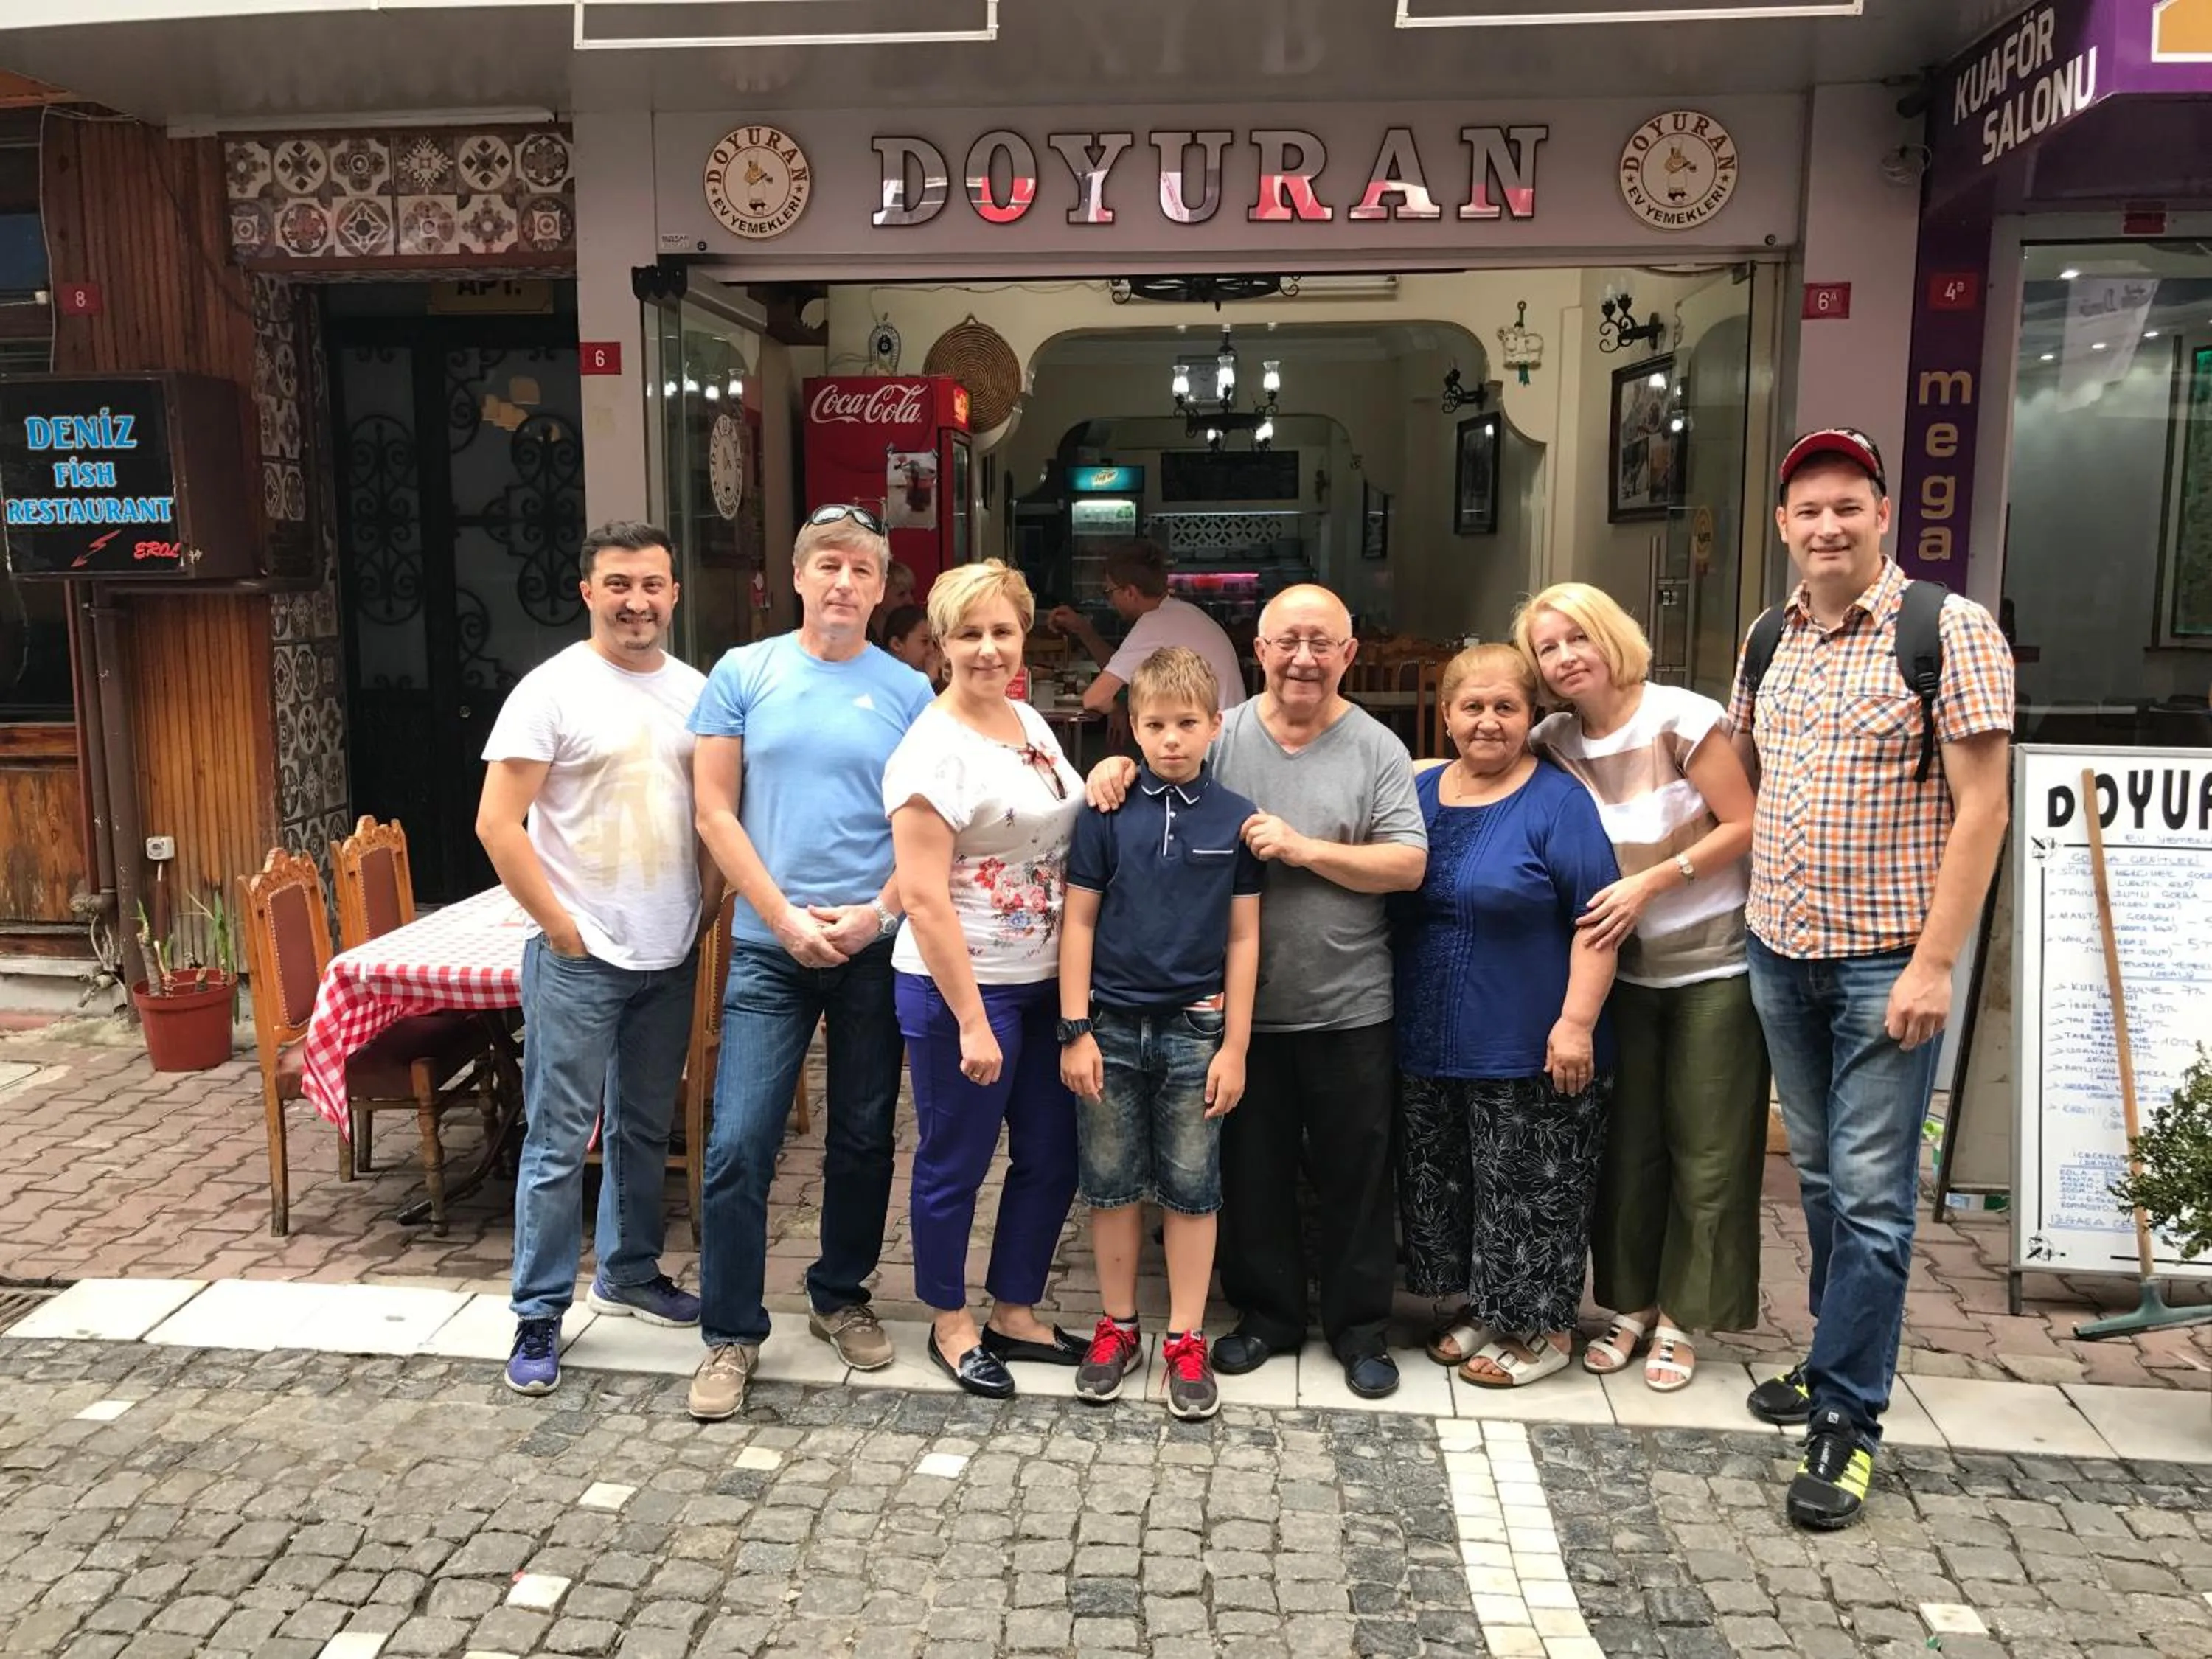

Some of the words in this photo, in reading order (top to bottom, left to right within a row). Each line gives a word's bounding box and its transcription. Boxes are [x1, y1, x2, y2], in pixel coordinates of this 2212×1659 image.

[1954, 7, 2055, 125] KUAFÖR
[1982, 46, 2098, 165] SALONU
[706, 128, 808, 184] DOYURAN
[1623, 114, 1736, 173] DOYURAN
[871, 125, 1548, 226] DOYURAN
[1628, 186, 1645, 206] EV
[712, 198, 729, 216] EV
[76, 291, 86, 307] 8
[595, 349, 605, 367] 6
[811, 384, 928, 425] Coca-Cola
[24, 406, 138, 450] DENİZ
[1919, 370, 1972, 560] mega
[6, 496, 175, 524] RESTAURANT
